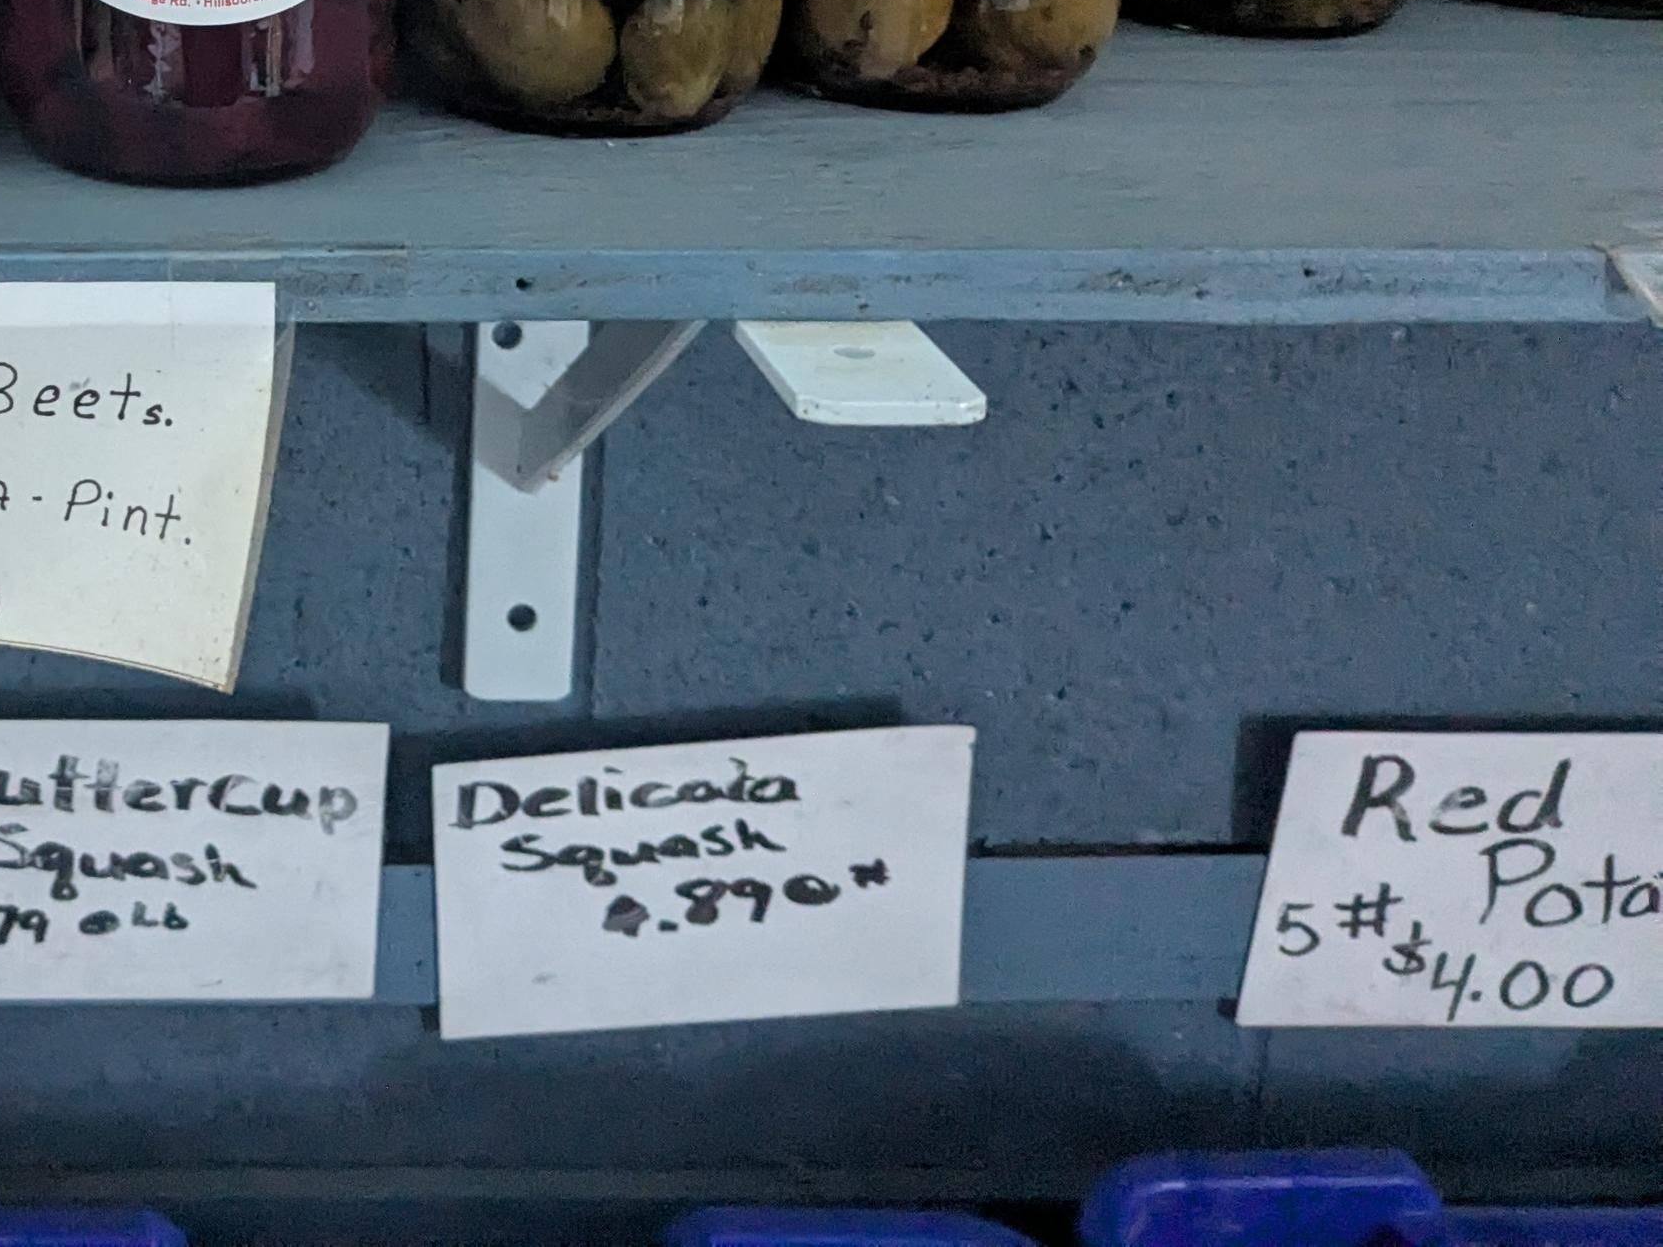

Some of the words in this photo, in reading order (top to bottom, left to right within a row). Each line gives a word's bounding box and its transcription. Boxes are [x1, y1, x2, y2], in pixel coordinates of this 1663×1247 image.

[64, 479, 192, 546] Pint.
[449, 757, 800, 829] Delicata
[1341, 754, 1572, 842] Red
[501, 819, 786, 887] Squash
[1479, 837, 1661, 928] Pota
[1383, 920, 1614, 1022] $4.00
